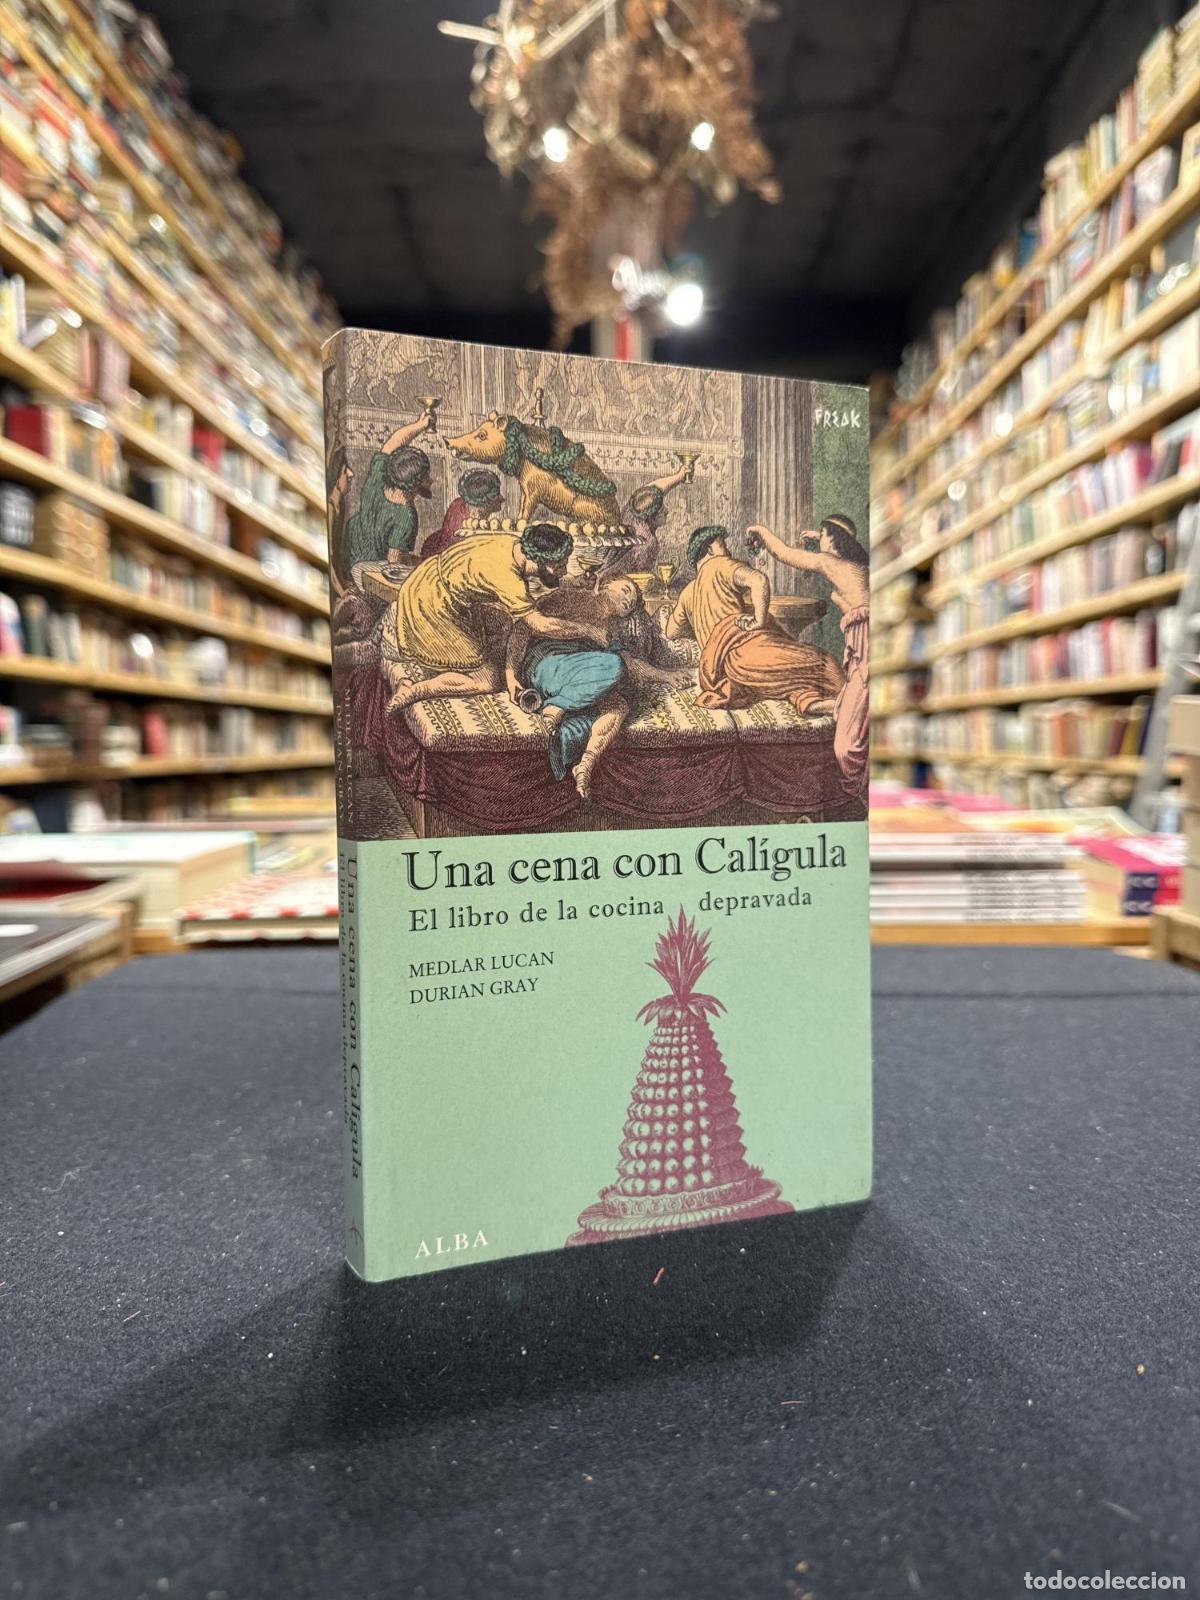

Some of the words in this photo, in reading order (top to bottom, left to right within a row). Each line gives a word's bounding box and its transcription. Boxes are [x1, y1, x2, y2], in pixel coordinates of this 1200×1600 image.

[347, 857, 358, 914] Una
[402, 850, 495, 890] Una
[508, 853, 600, 885] cena
[613, 850, 683, 879] con
[695, 833, 847, 881] Calígula
[408, 907, 438, 932] El
[448, 903, 509, 929] libro
[520, 901, 548, 923] de
[557, 898, 578, 920] la
[589, 896, 664, 918] cocina
[699, 888, 813, 916] depravada
[348, 927, 356, 989] cena
[409, 957, 486, 978] MEDLAR
[491, 951, 555, 970] LUCAN
[409, 982, 485, 1004] DURIAN
[490, 977, 539, 996] GRAY
[350, 1064, 361, 1179] Calígula
[415, 1230, 489, 1260] ALBA
